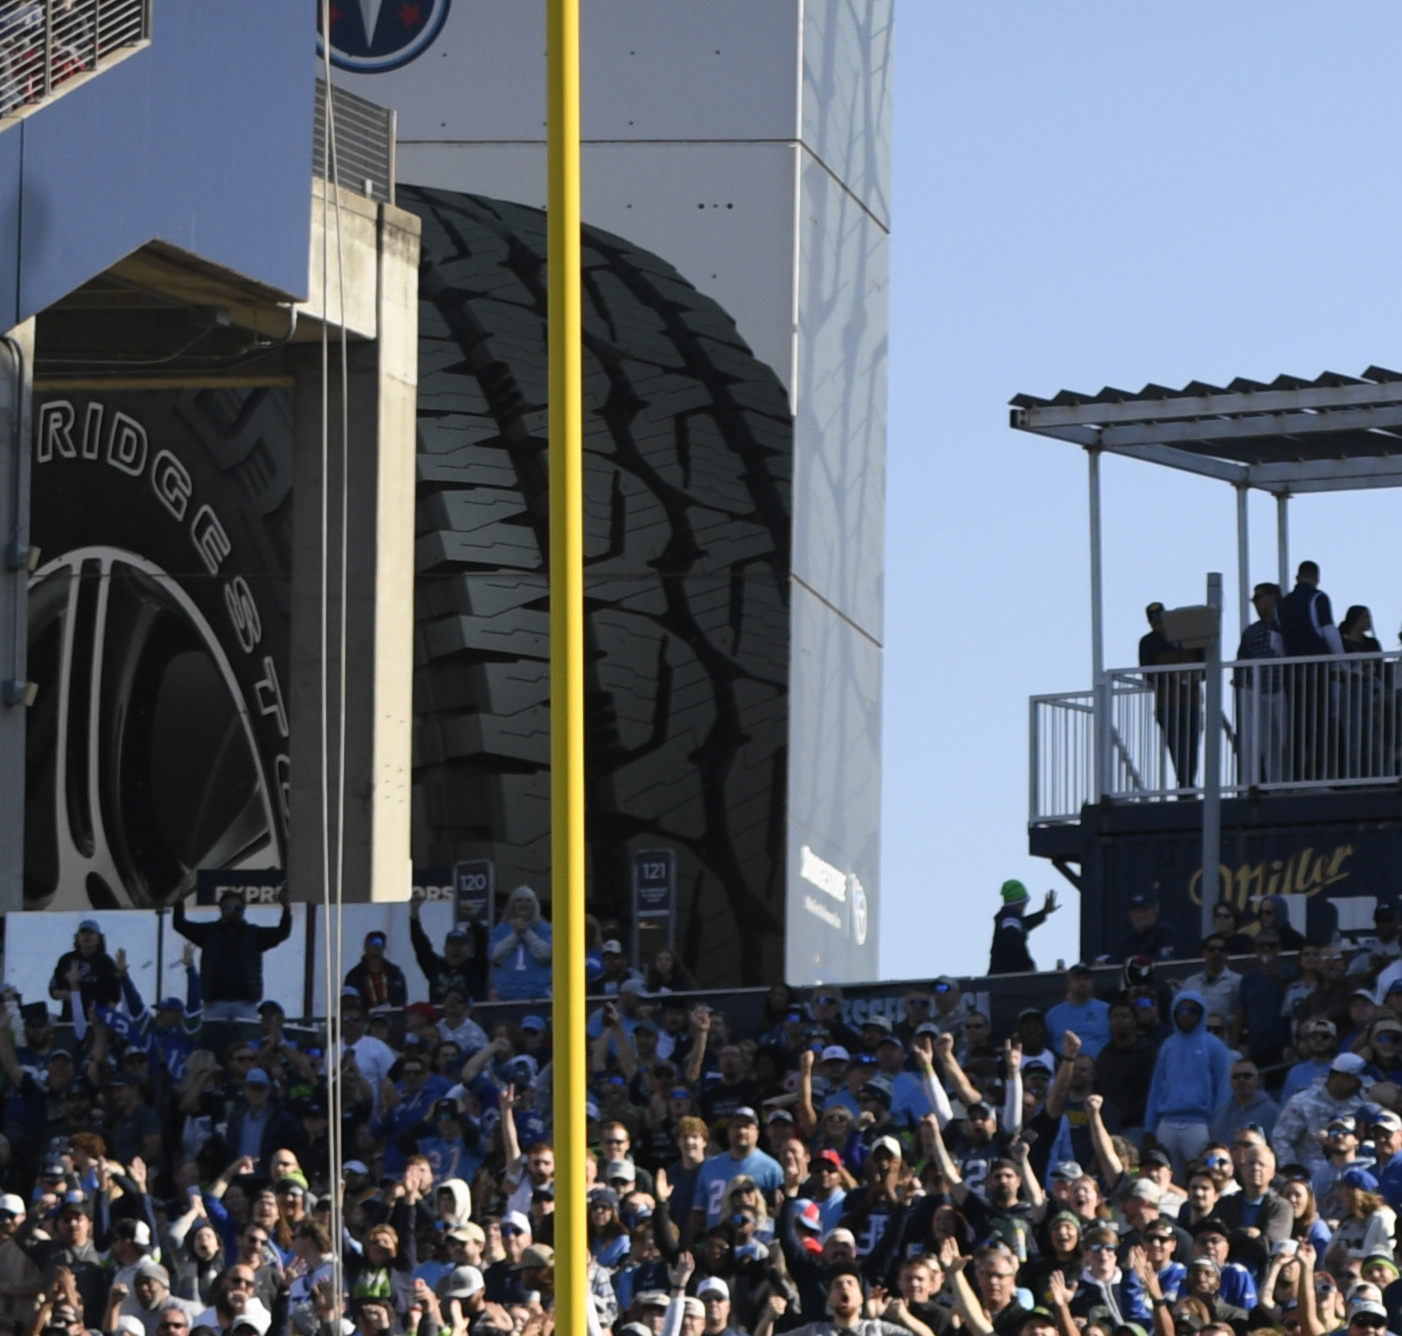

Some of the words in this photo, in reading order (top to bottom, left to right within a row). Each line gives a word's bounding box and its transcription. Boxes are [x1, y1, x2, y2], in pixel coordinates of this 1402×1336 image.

[643, 862, 667, 880] 121
[460, 873, 487, 891] 120
[514, 943, 527, 971] 1
